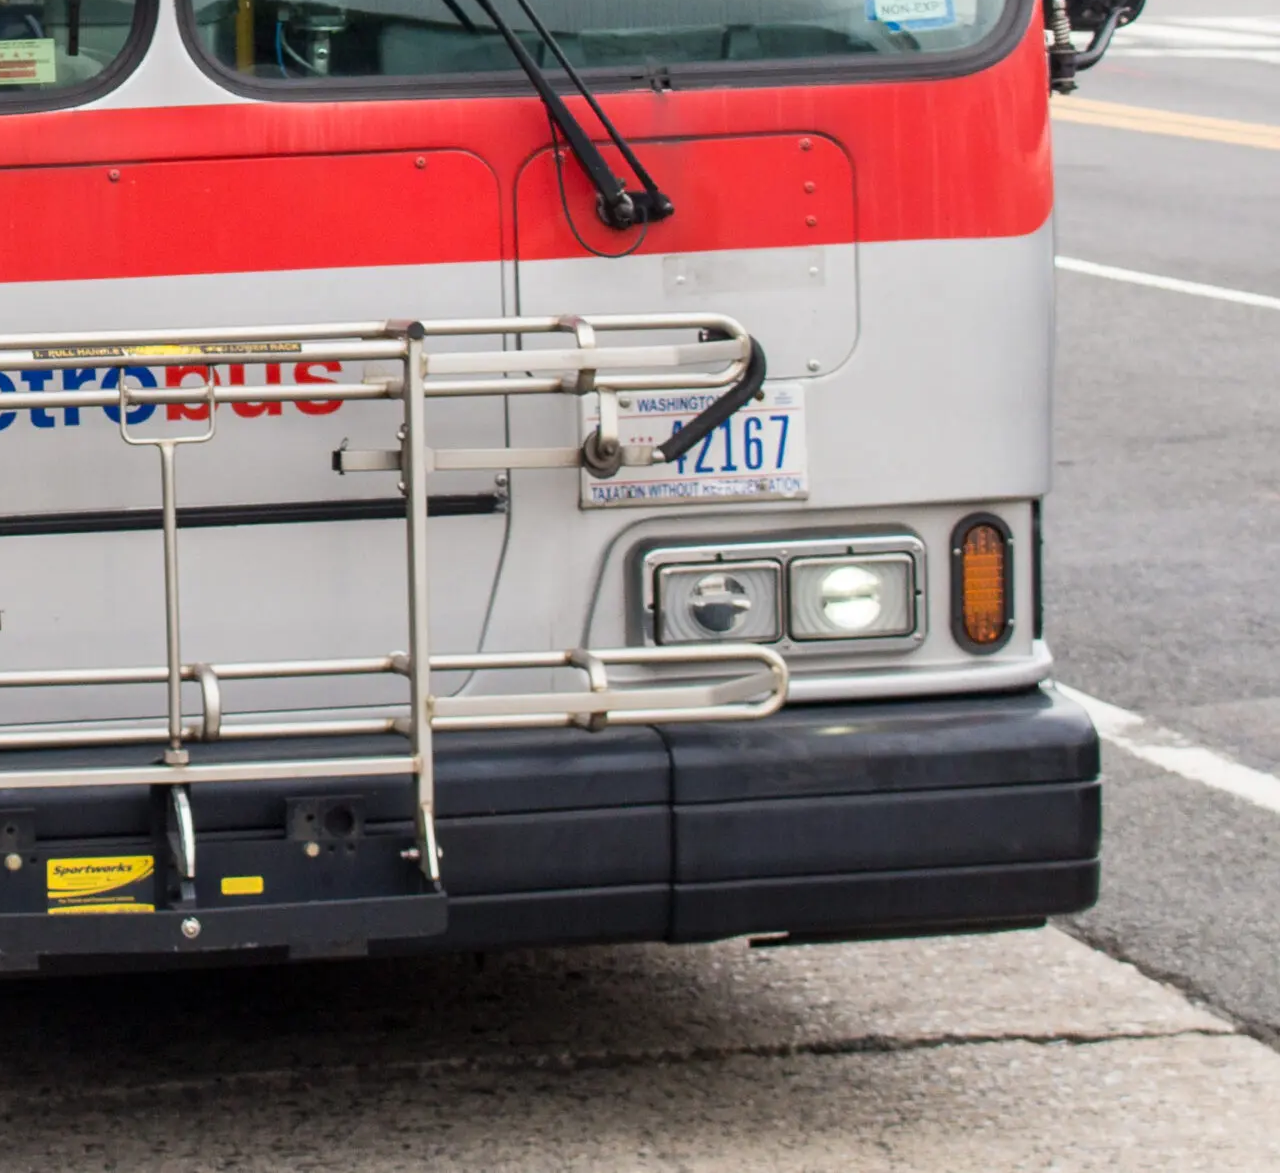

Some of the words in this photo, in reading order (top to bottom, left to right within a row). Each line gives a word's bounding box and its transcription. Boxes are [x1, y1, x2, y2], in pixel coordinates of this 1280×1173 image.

[637, 396, 719, 413] WASHINGTO
[591, 484, 645, 500] TAXATION
[649, 482, 699, 498] WITHOUT
[53, 862, 134, 877] Sportworks
